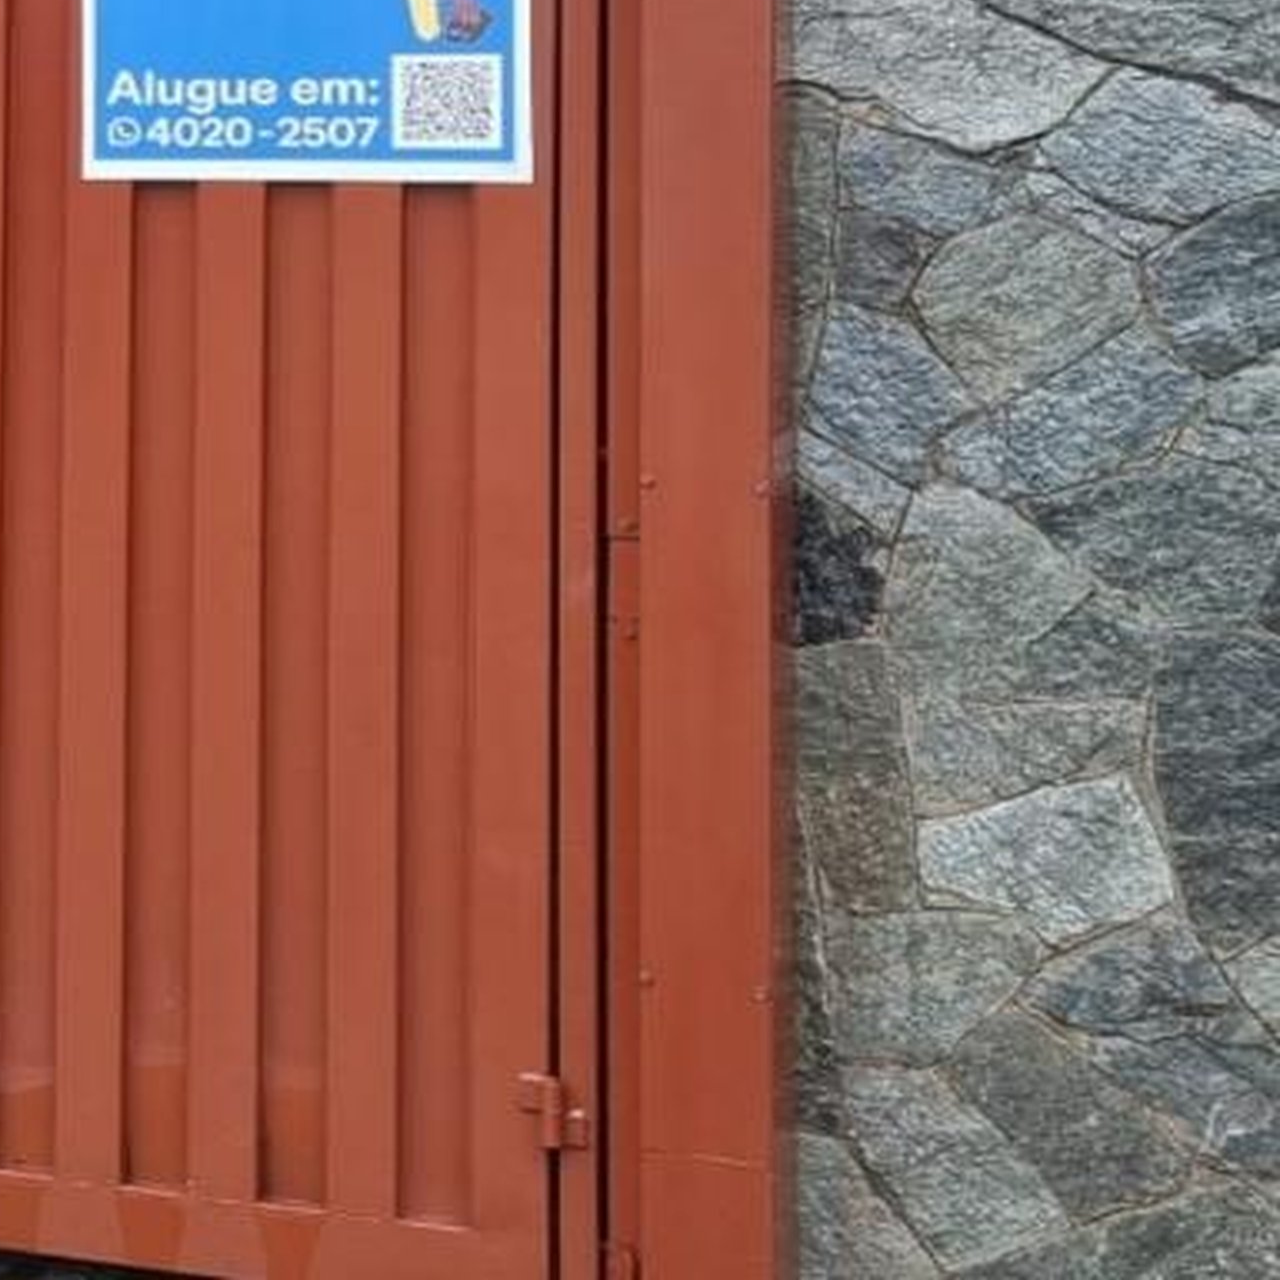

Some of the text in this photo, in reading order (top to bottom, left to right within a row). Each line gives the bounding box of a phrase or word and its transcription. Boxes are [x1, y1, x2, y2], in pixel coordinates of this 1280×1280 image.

[107, 69, 380, 114] Alugue em:
[147, 116, 378, 147] 4020-2507
